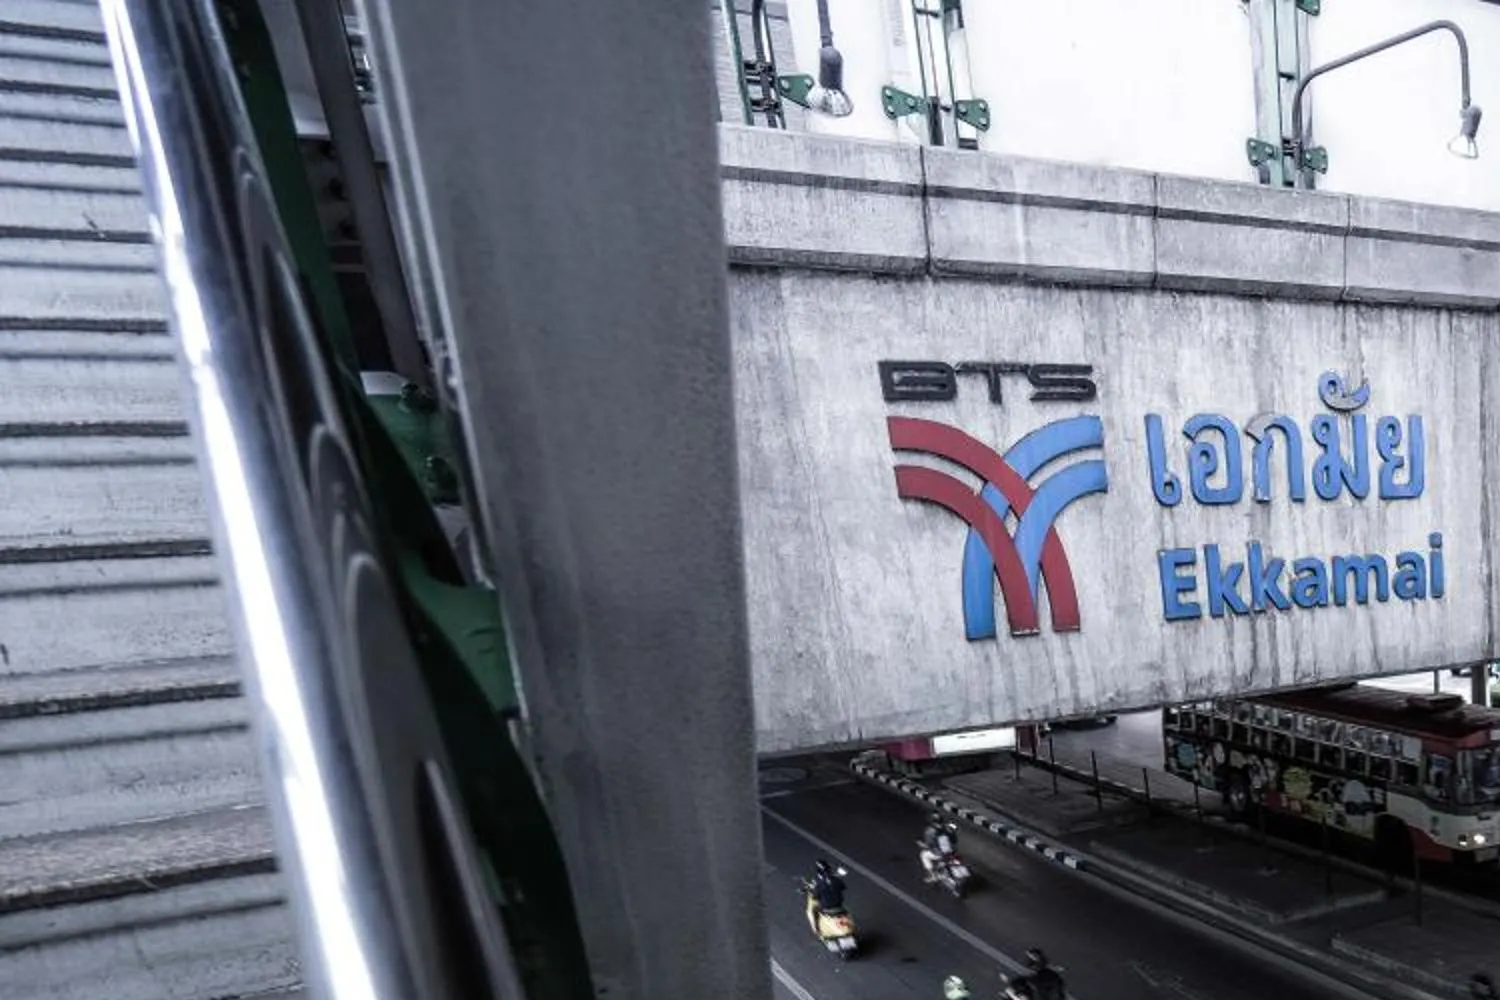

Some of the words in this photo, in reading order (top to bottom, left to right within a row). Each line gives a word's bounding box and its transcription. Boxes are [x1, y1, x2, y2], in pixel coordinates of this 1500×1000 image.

[878, 359, 1097, 405] BTS
[1143, 369, 1426, 507] เอกมัย
[1156, 532, 1445, 622] Ekkamai
